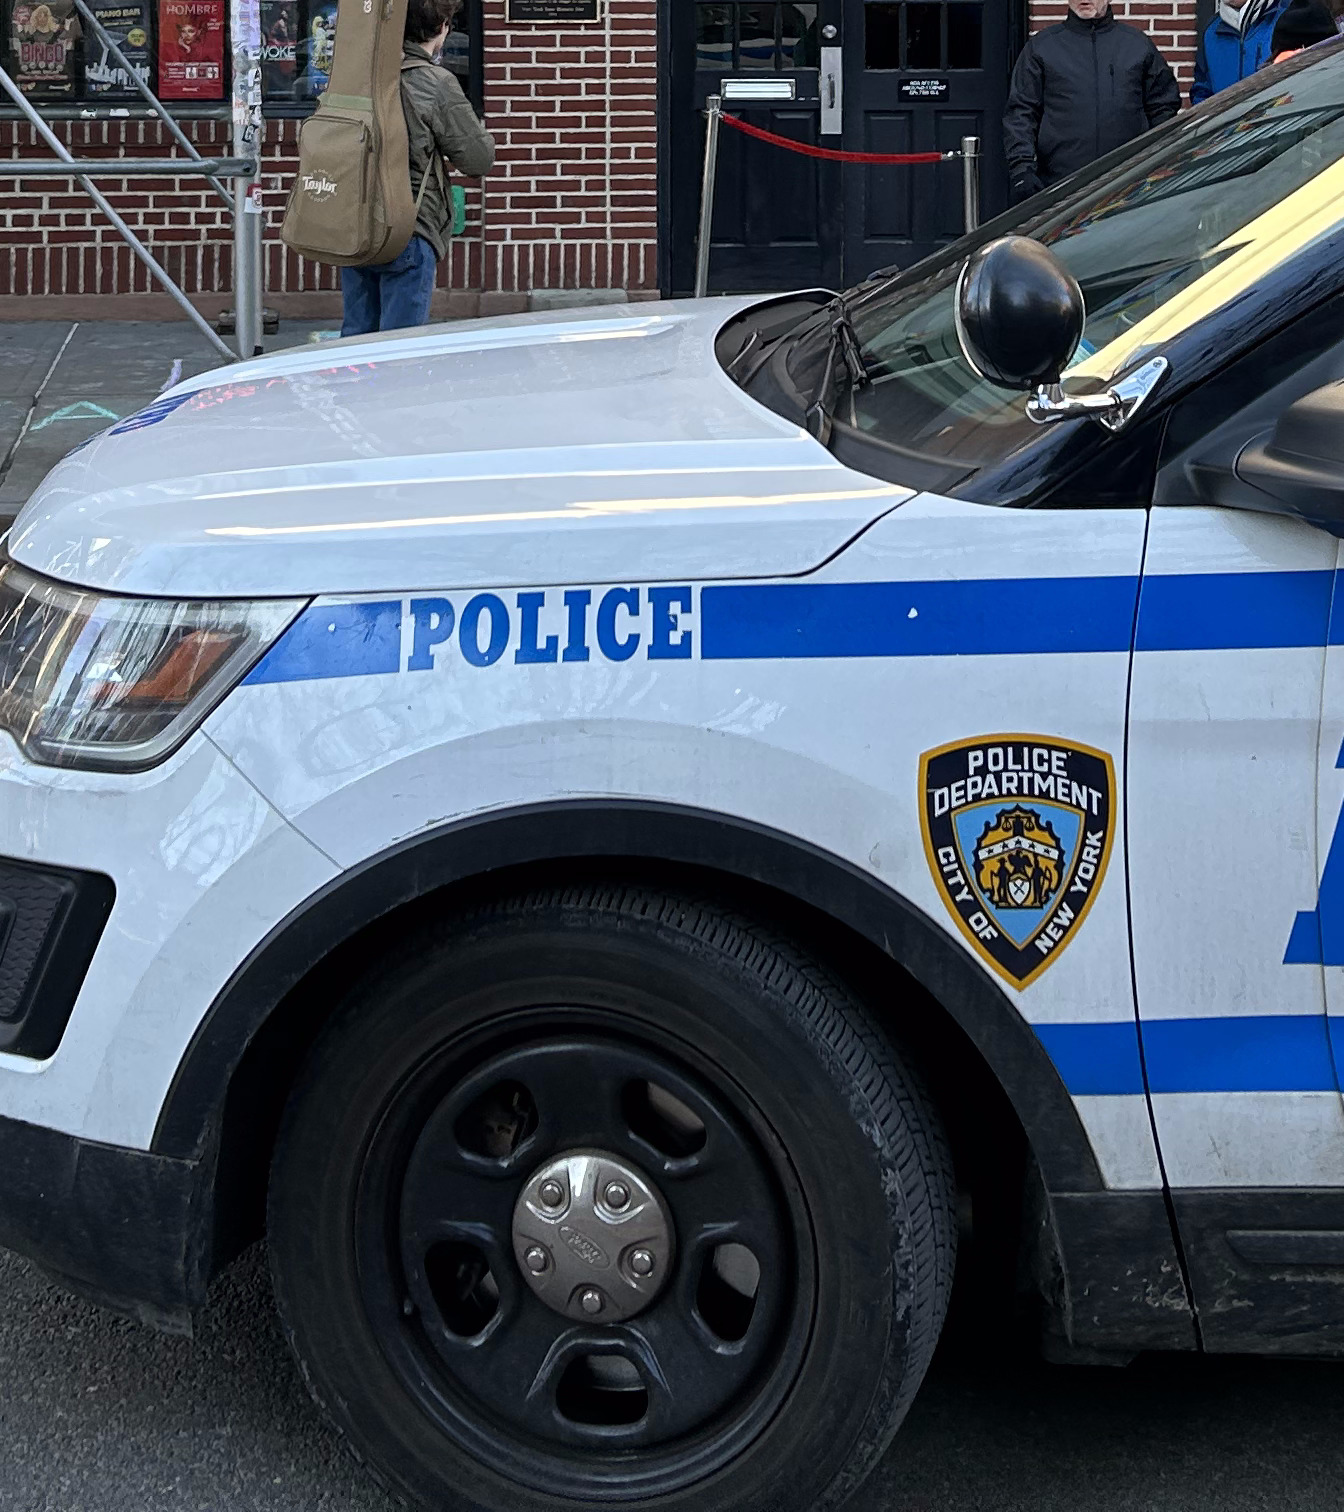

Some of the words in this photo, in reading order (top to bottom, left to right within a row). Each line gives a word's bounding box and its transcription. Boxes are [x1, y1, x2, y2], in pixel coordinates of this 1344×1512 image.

[166, 3, 218, 15] HOMBRE
[20, 41, 66, 64] BINGO
[302, 175, 338, 195] Taylor
[408, 586, 692, 672] POLICE
[968, 746, 1068, 777] POLICE
[933, 772, 1103, 818] DEPARTMENT
[937, 845, 974, 904] CITY
[968, 911, 999, 941] OF
[1034, 902, 1075, 955] NEW
[1070, 829, 1104, 894] YORK
